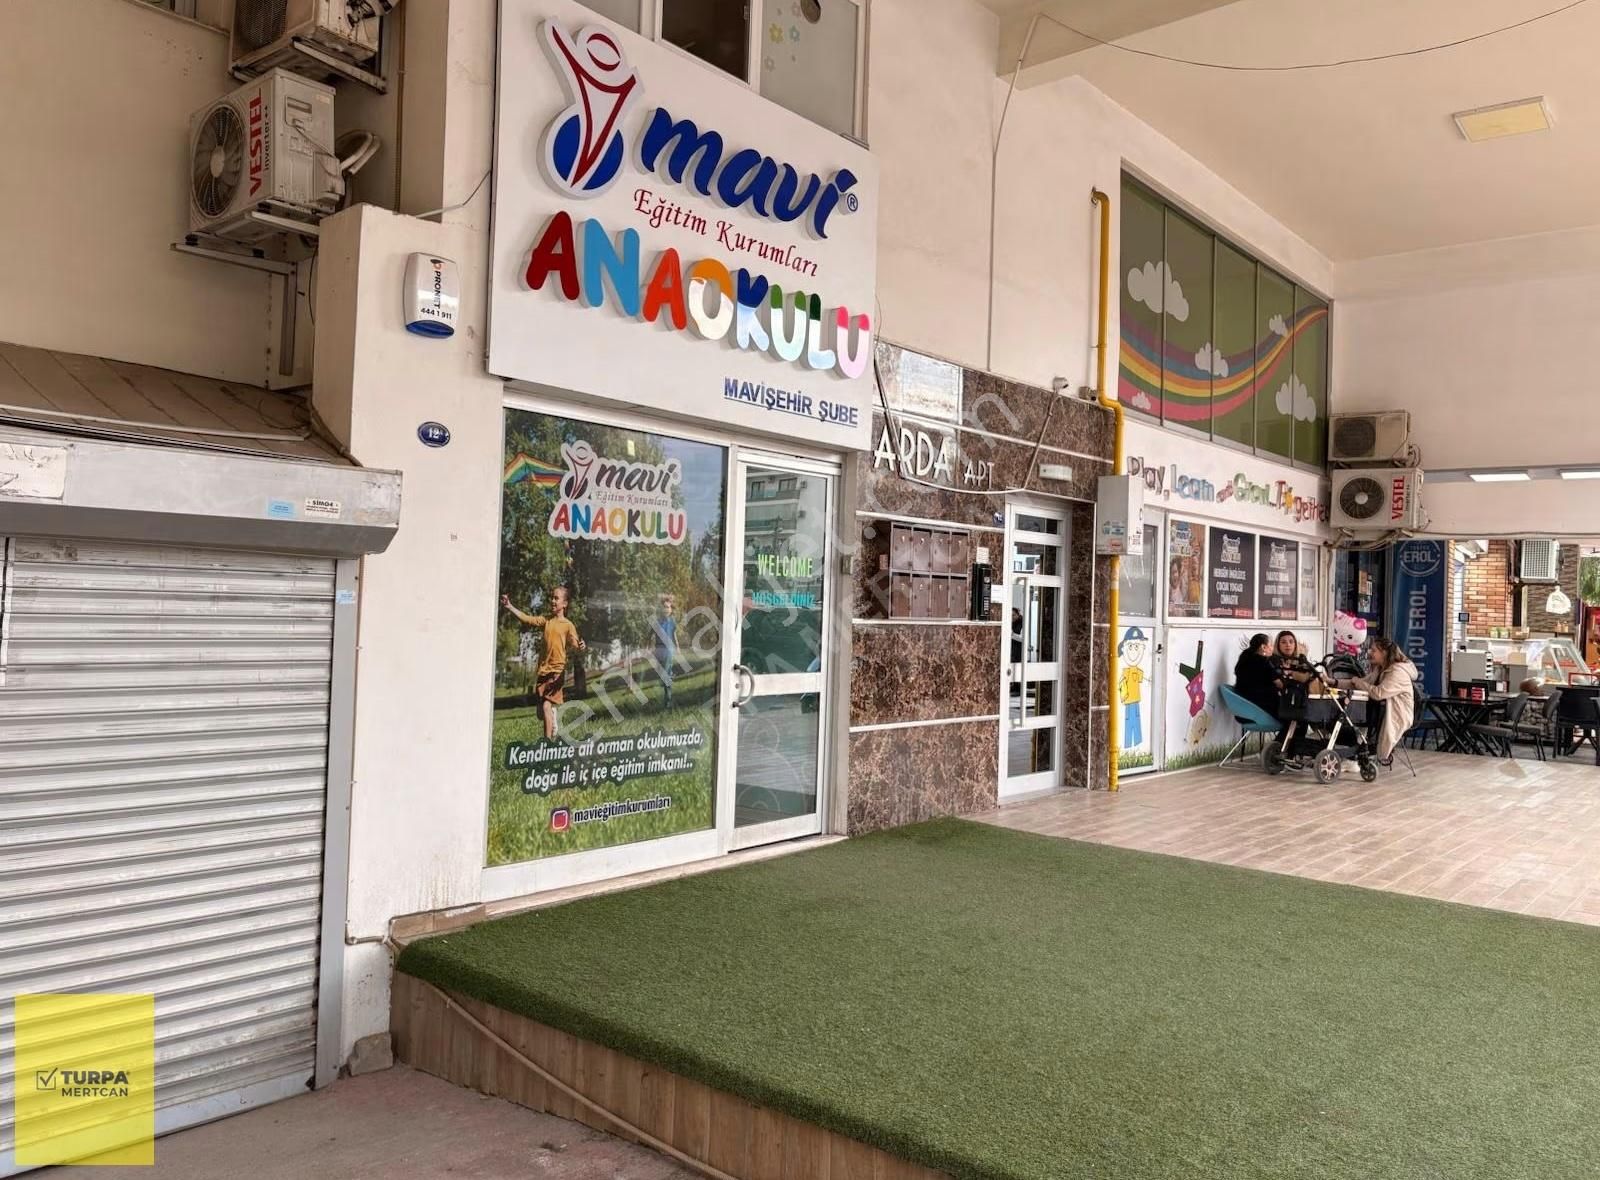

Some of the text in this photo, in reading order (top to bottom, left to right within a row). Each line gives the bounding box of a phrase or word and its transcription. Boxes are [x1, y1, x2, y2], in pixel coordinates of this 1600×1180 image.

[250, 87, 262, 197] VESTEL
[634, 188, 818, 277] Eğitim Kurumları
[421, 307, 435, 315] 444
[524, 210, 871, 380] ANAOKULU
[724, 376, 859, 426] MAVİŞEHİR ŞUBE
[596, 463, 677, 492] mavi
[873, 426, 995, 489] ARDA APT
[1391, 475, 1405, 520] VESTEL
[553, 501, 684, 540] ANAOKULU
[757, 553, 814, 578] WELCOME
[1403, 551, 1436, 563] EROL
[1409, 584, 1427, 630] EROL
[509, 728, 703, 765] Kendimize ait orman okulumuzda,
[525, 769, 558, 792] doğa
[561, 766, 576, 784] ile
[580, 766, 589, 785] iç
[592, 763, 607, 784] içe
[611, 758, 645, 781] eğitim
